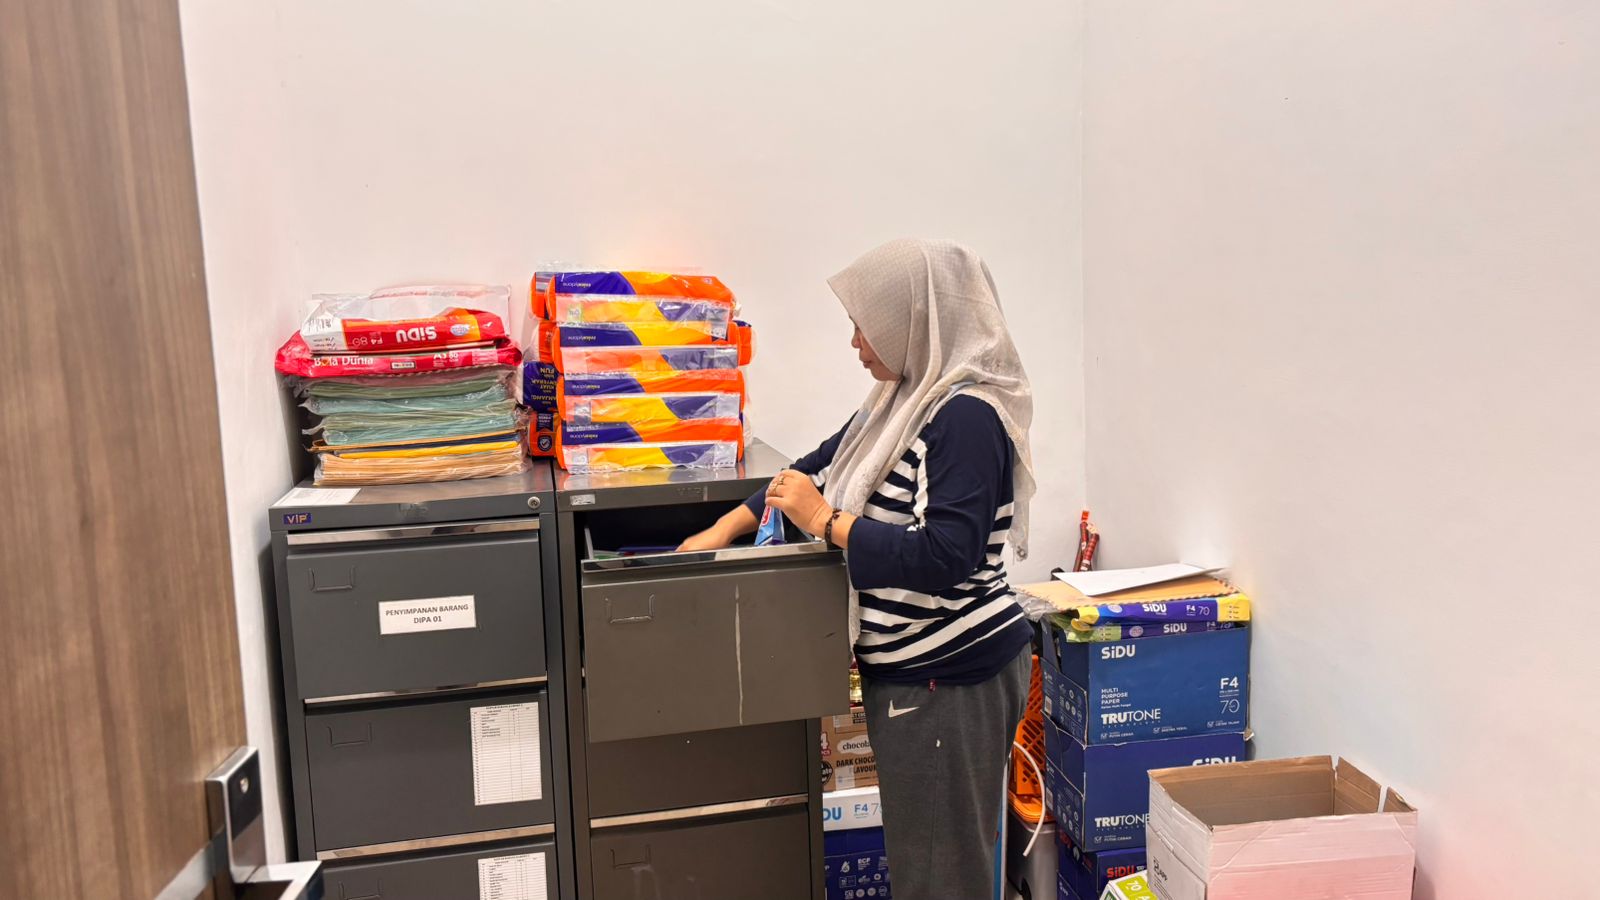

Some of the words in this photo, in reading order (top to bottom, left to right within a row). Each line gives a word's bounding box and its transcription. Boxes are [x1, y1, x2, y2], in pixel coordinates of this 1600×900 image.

[385, 606, 438, 616] PENYIMPANAN
[439, 604, 468, 612] BARANG
[1142, 603, 1167, 613] SiDU
[413, 616, 432, 624] DIPA
[1163, 622, 1188, 634] SiDU
[1101, 644, 1136, 660] SiDU
[1220, 677, 1239, 690] F4
[1220, 699, 1240, 714] 70
[1101, 708, 1161, 725] TRUTONE
[836, 758, 854, 767] DARK
[854, 756, 875, 765] CHOCO
[853, 764, 876, 774] LAVOU
[822, 807, 841, 821] DU
[854, 803, 868, 812] F4
[871, 803, 882, 816] 7
